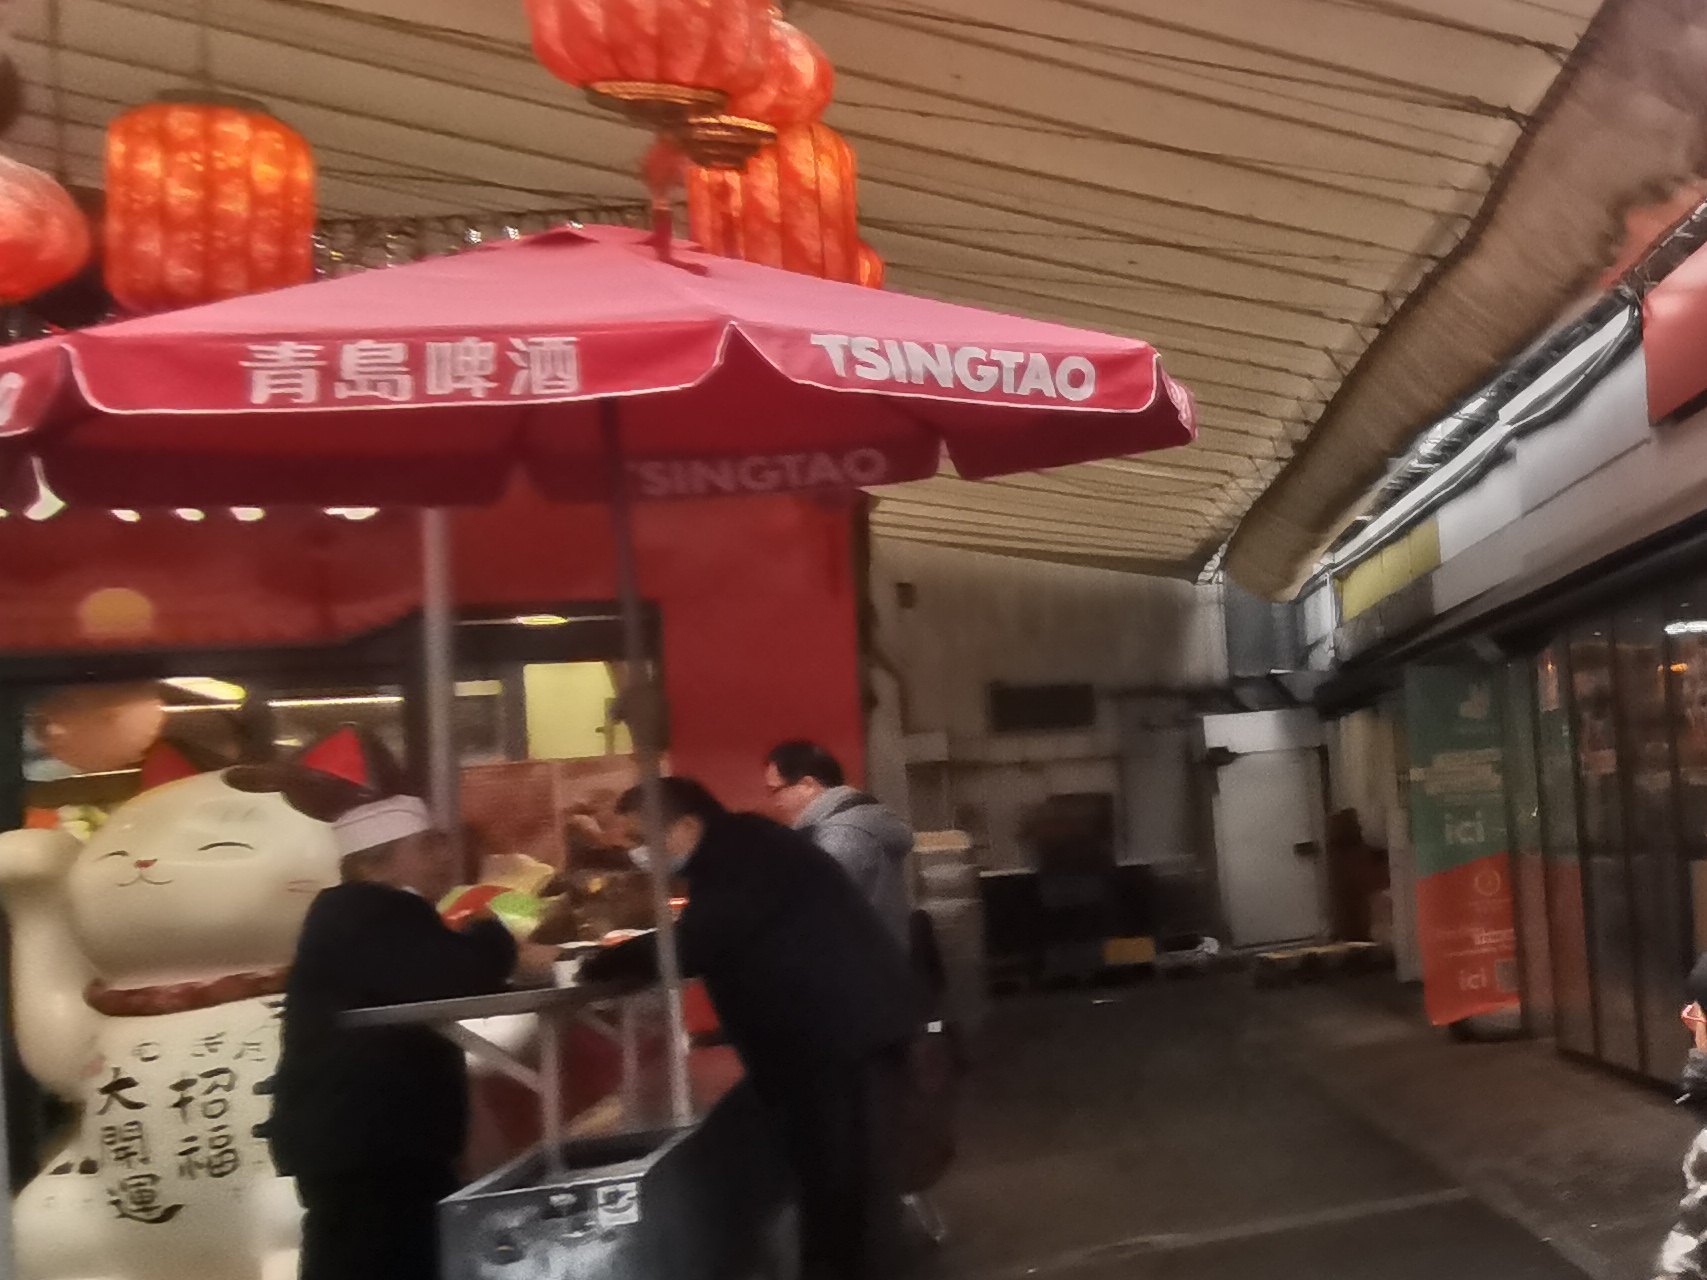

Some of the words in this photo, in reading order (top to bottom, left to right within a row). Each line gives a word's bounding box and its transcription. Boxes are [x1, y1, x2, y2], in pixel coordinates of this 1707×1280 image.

[239, 336, 580, 404] 青島啤酒
[811, 333, 1096, 402] TSINGTAO
[97, 1066, 183, 1224] 大開運
[169, 1067, 239, 1180] 招福
